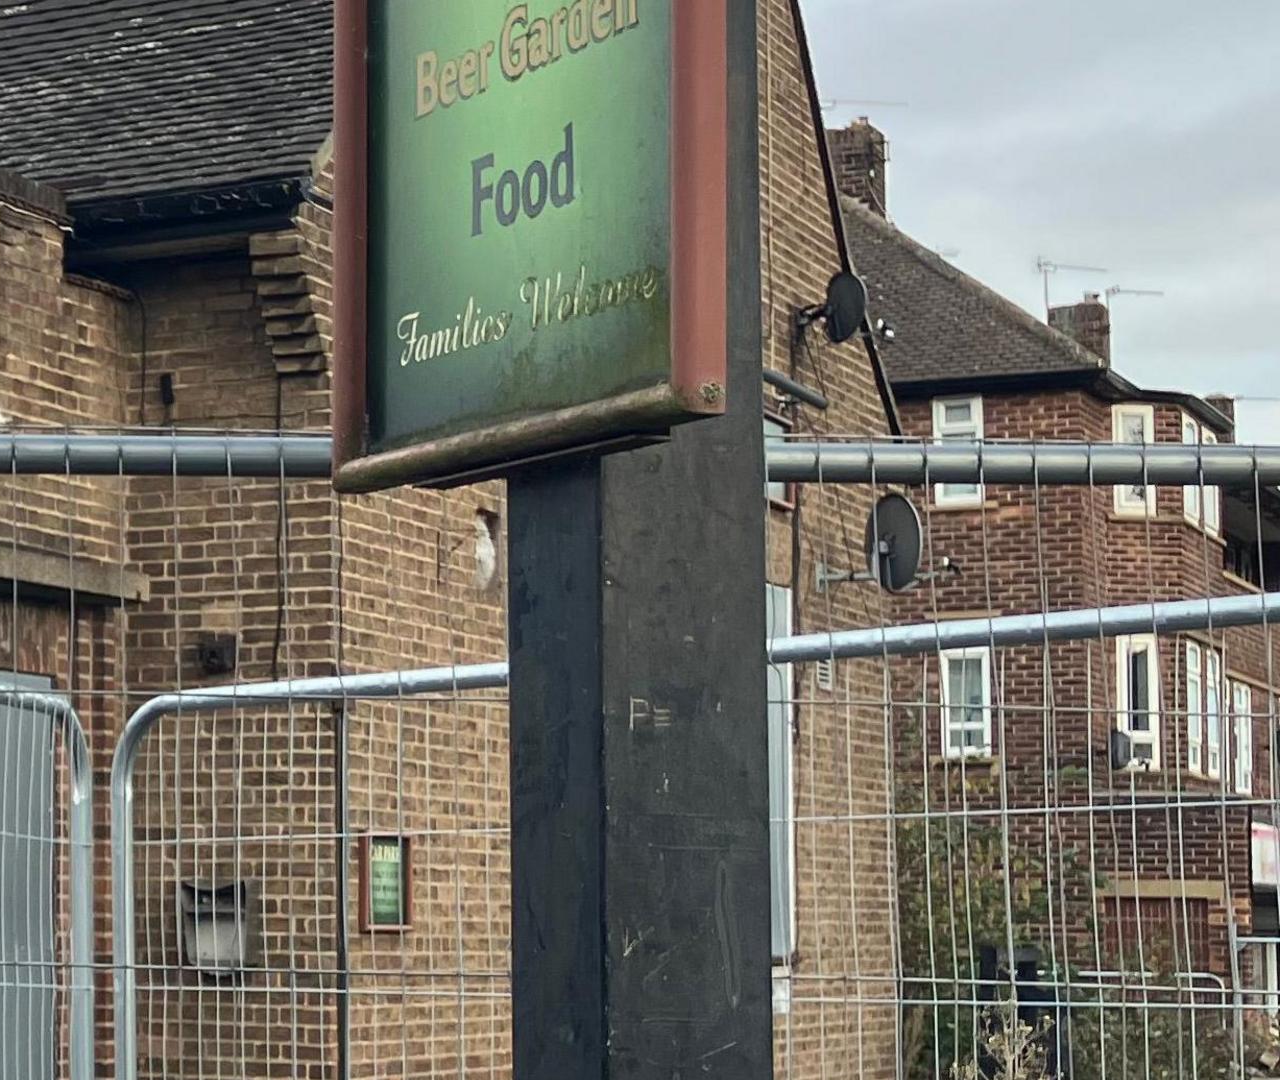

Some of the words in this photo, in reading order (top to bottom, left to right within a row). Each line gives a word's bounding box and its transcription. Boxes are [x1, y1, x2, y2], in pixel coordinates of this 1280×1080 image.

[415, 40, 495, 120] Beer
[499, 0, 639, 82] Garden
[470, 121, 577, 237] Food
[397, 296, 511, 367] Families
